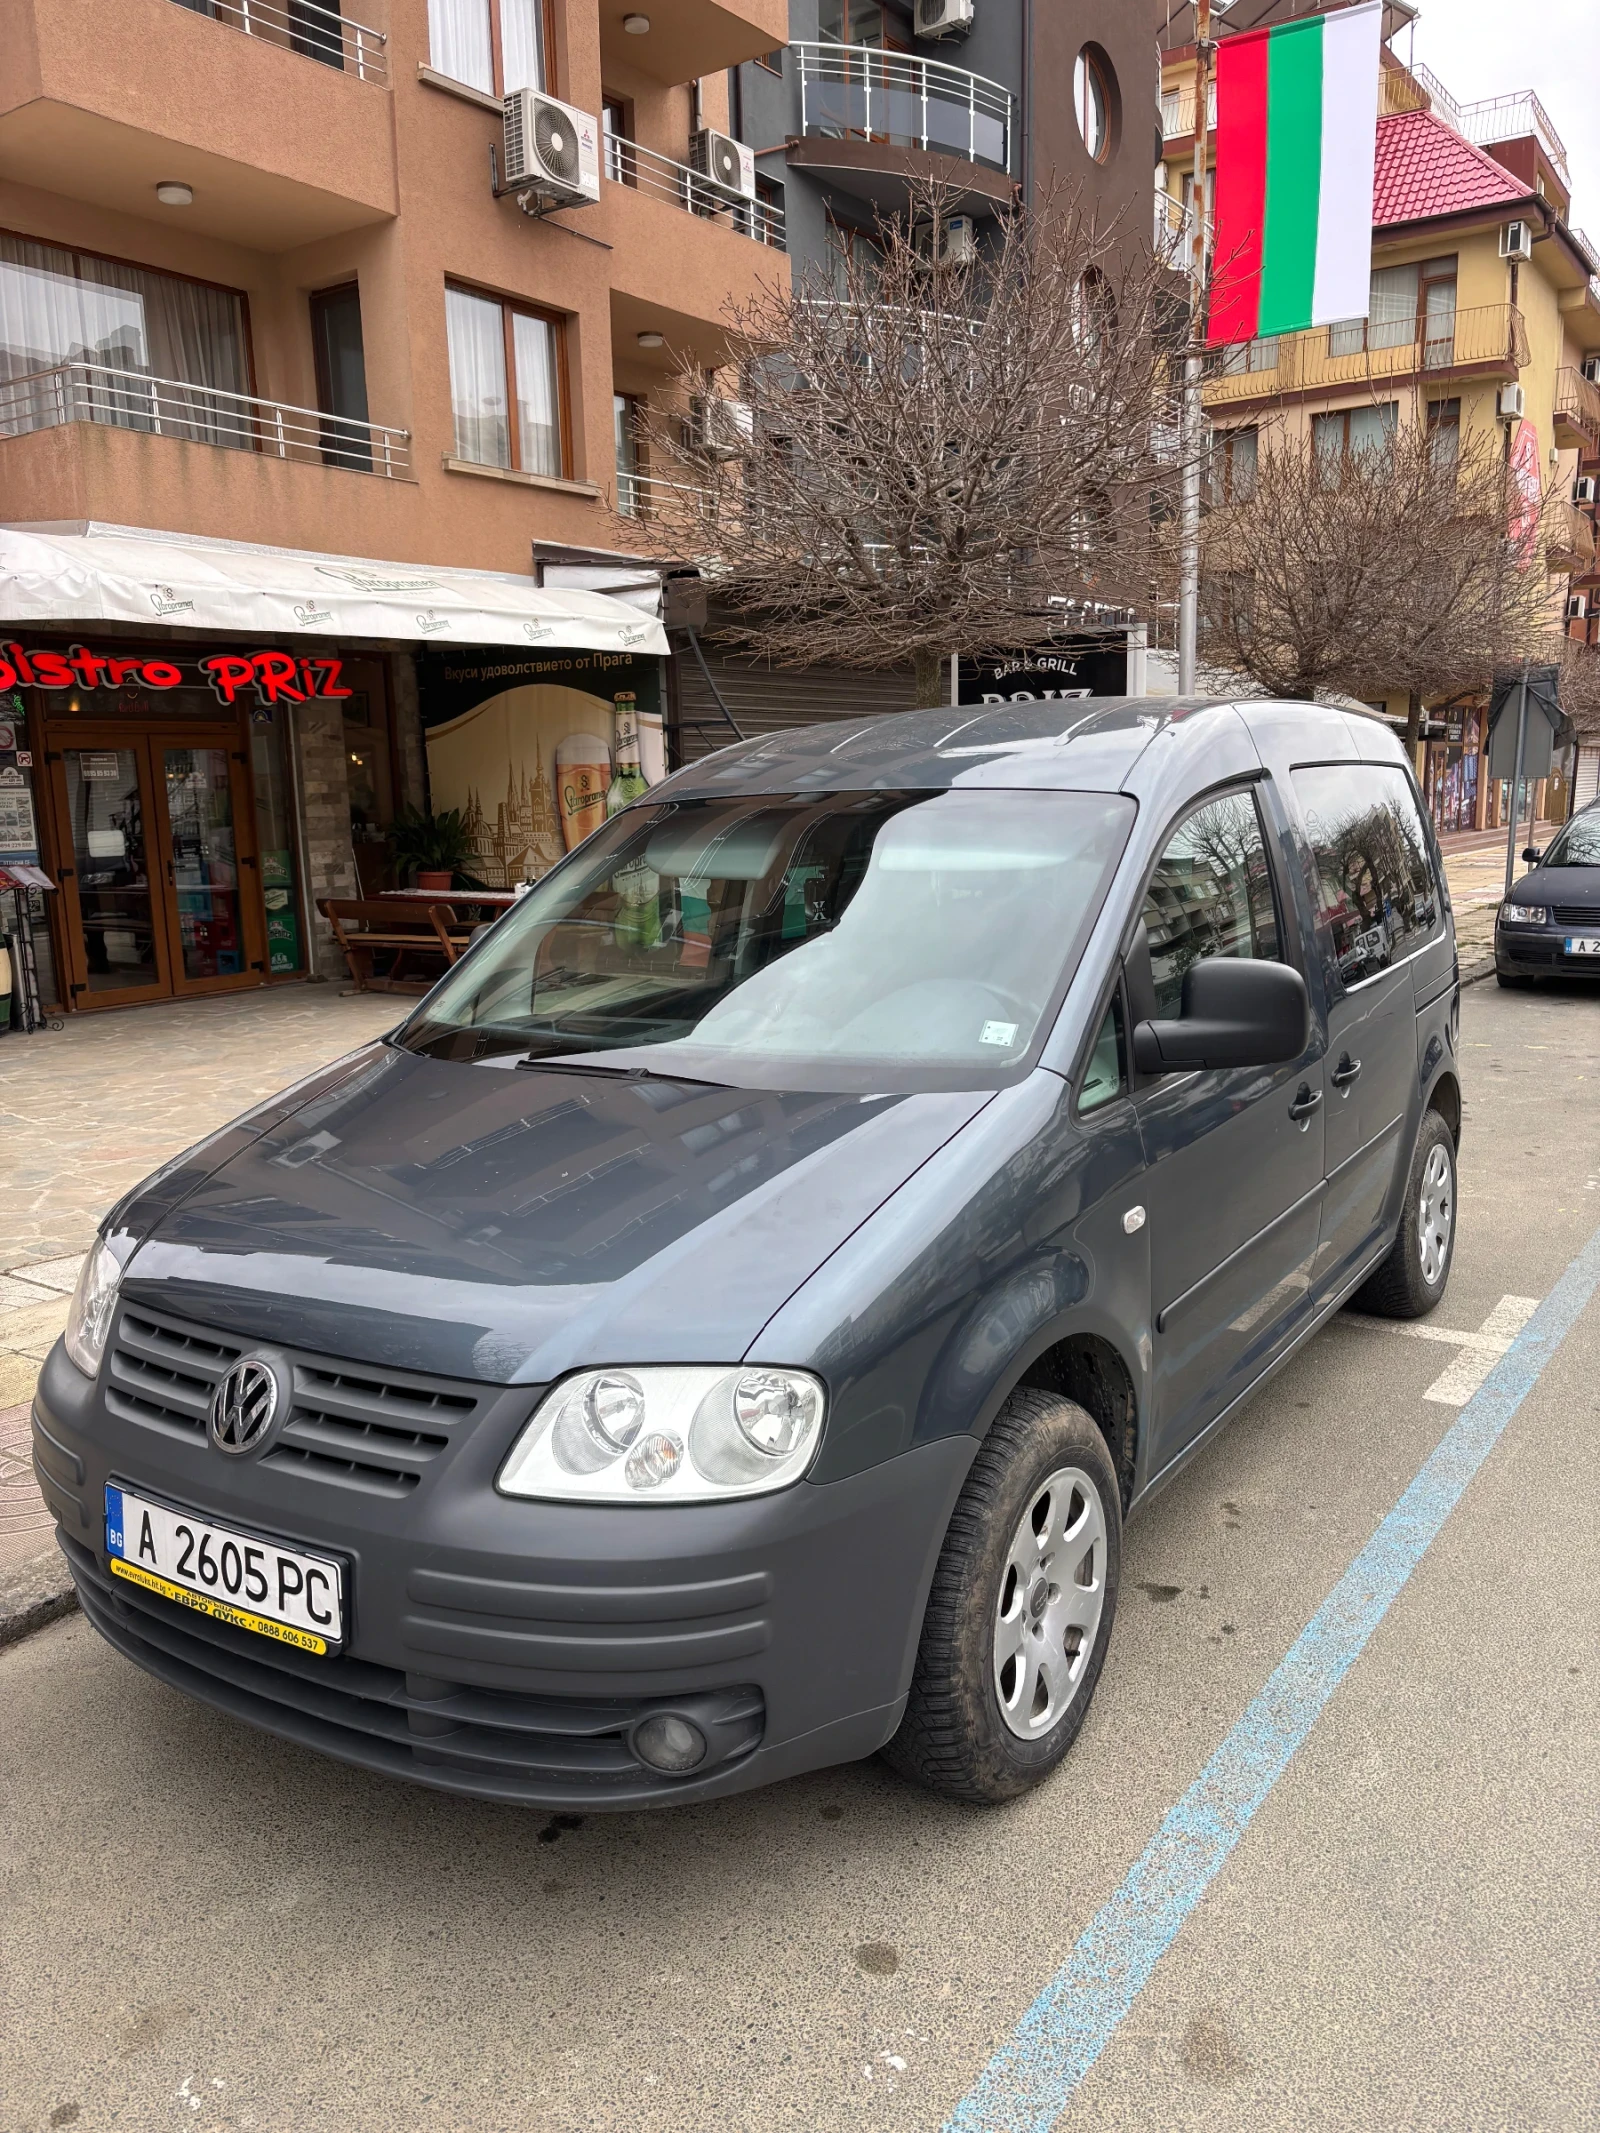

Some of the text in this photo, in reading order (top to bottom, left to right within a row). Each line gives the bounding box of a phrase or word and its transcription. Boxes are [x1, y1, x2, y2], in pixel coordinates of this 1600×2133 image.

[444, 652, 633, 683] Вкуси удоволствието от Прага
[993, 660, 1021, 680] BAR
[1037, 657, 1078, 676] GRILL
[1578, 940, 1586, 952] A
[110, 1509, 332, 1625] BG A 2605 PC
[174, 1591, 247, 1628] ЕВРО ЛУКС
[186, 1591, 234, 1614] АВТОКЪЩА
[258, 1621, 318, 1651] 0888 606 537
